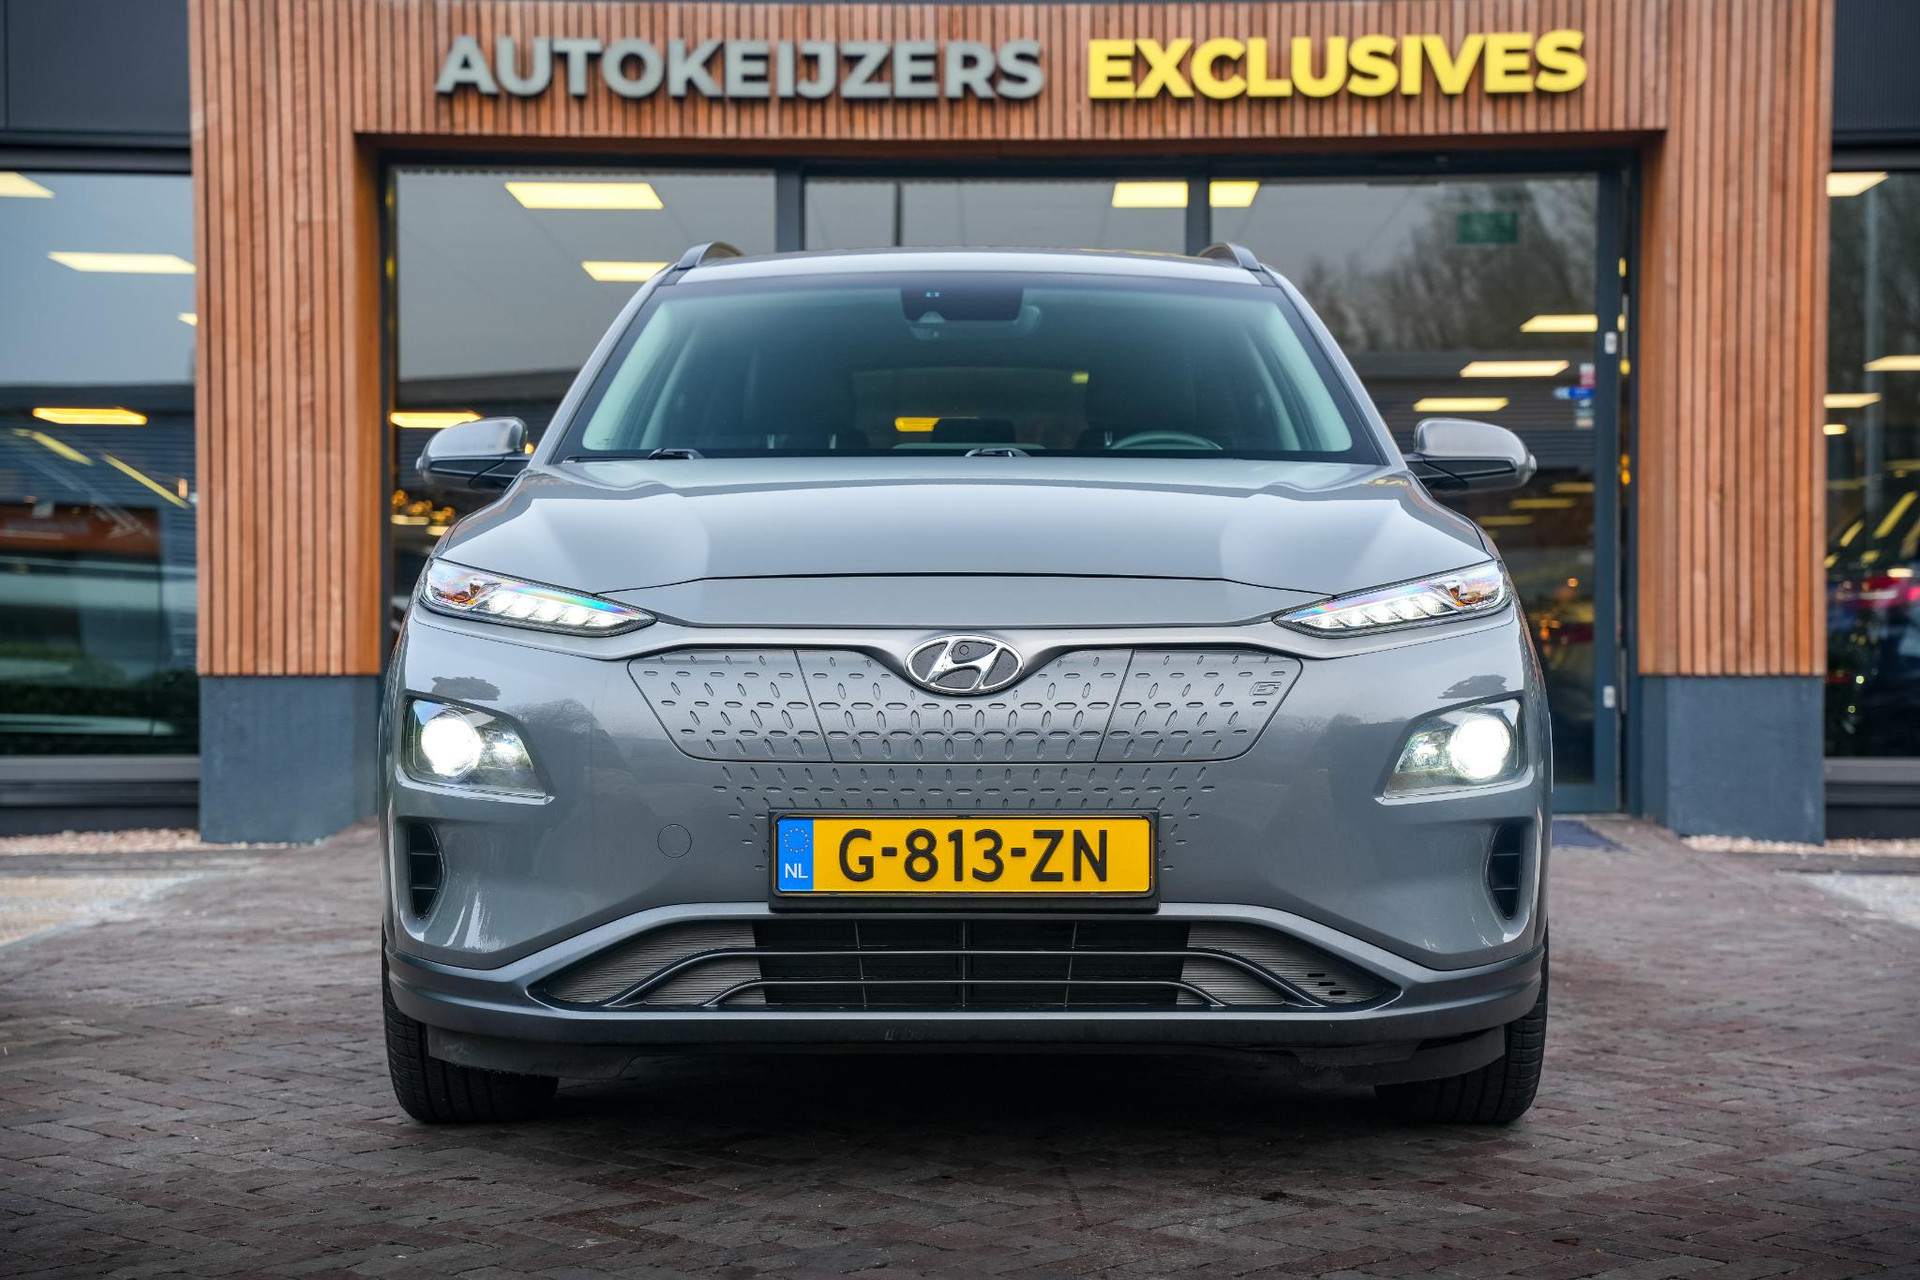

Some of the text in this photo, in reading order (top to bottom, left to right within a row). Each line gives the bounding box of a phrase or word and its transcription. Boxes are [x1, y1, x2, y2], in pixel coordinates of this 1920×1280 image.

[434, 29, 1589, 101] AUTOKEIJZERS EXCLUSIVES
[784, 828, 1108, 882] NL G-813-ZN
